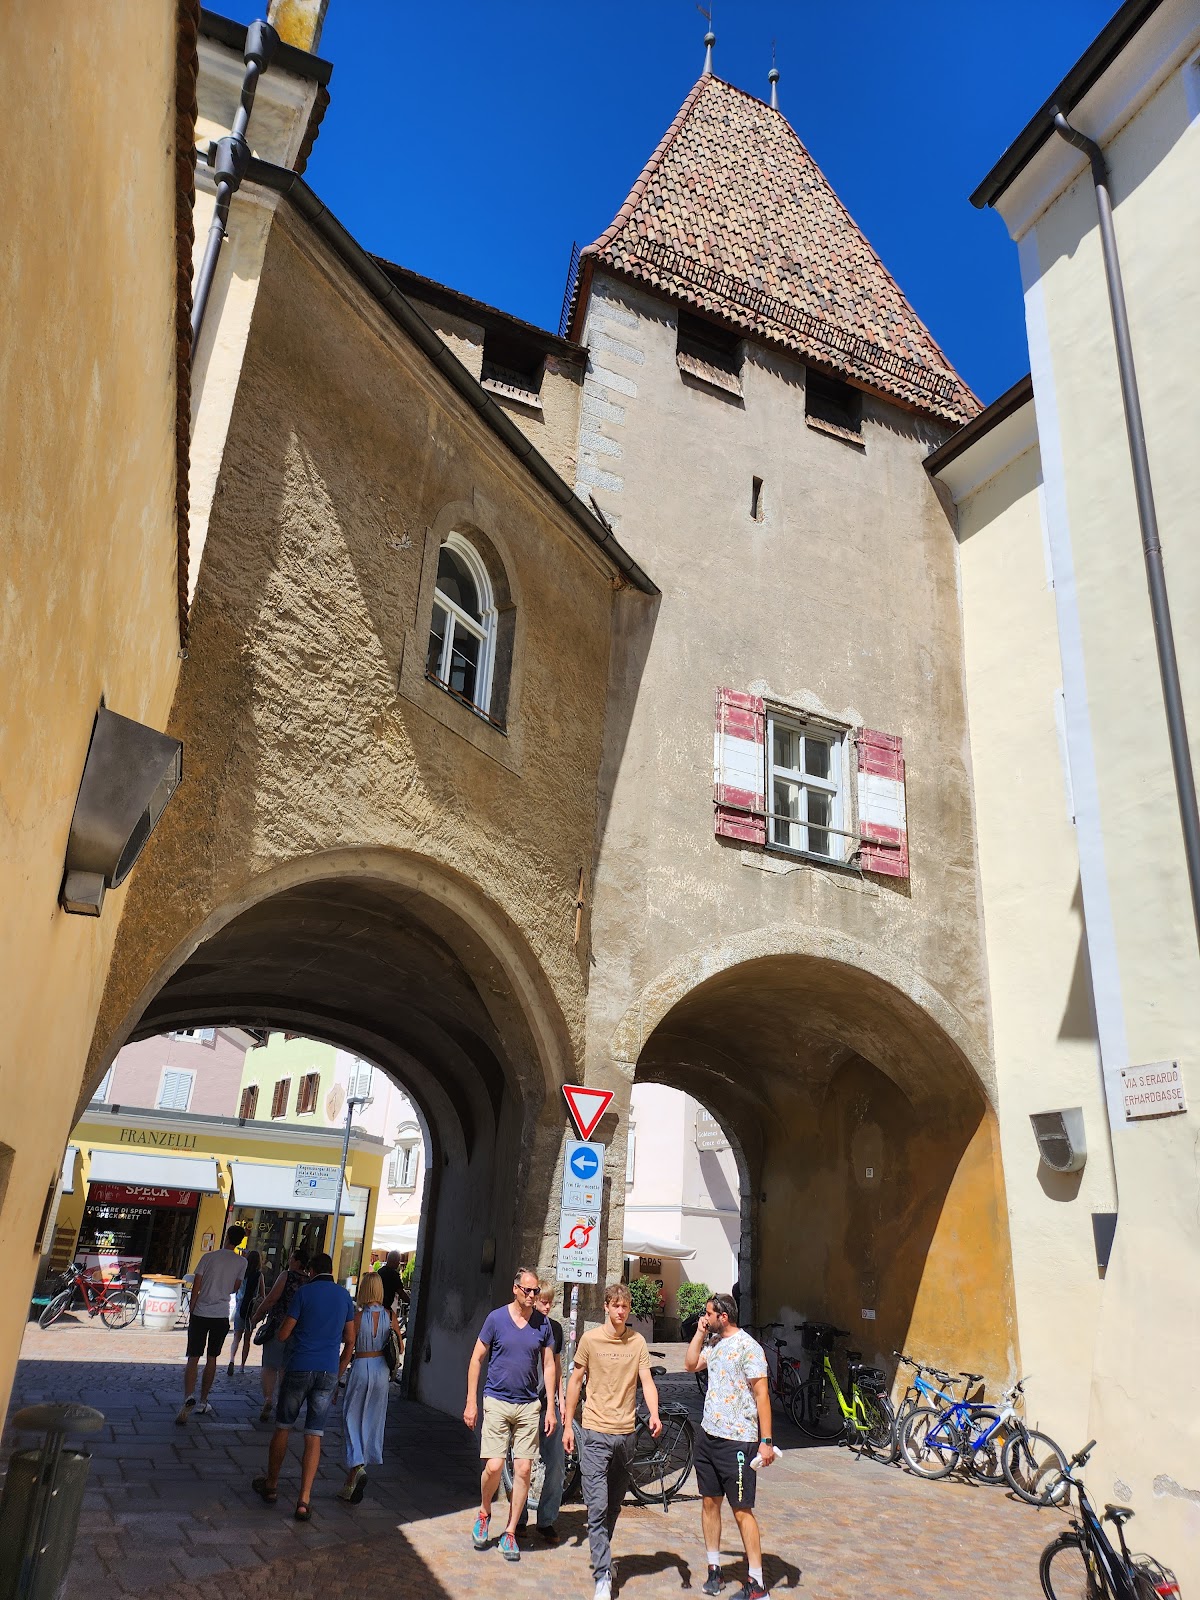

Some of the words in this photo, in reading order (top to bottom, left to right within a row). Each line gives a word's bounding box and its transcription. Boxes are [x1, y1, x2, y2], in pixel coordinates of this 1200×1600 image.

[1124, 1078, 1137, 1088] VIA
[1139, 1071, 1177, 1086] S.ERARDO
[1125, 1088, 1182, 1106] ERHARDGASSE
[120, 1128, 197, 1148] FRANZELLI
[125, 1185, 169, 1197] SPECK
[86, 1205, 120, 1213] TAGLIERE
[639, 1256, 662, 1266] TAPAS
[576, 1269, 583, 1278] 5
